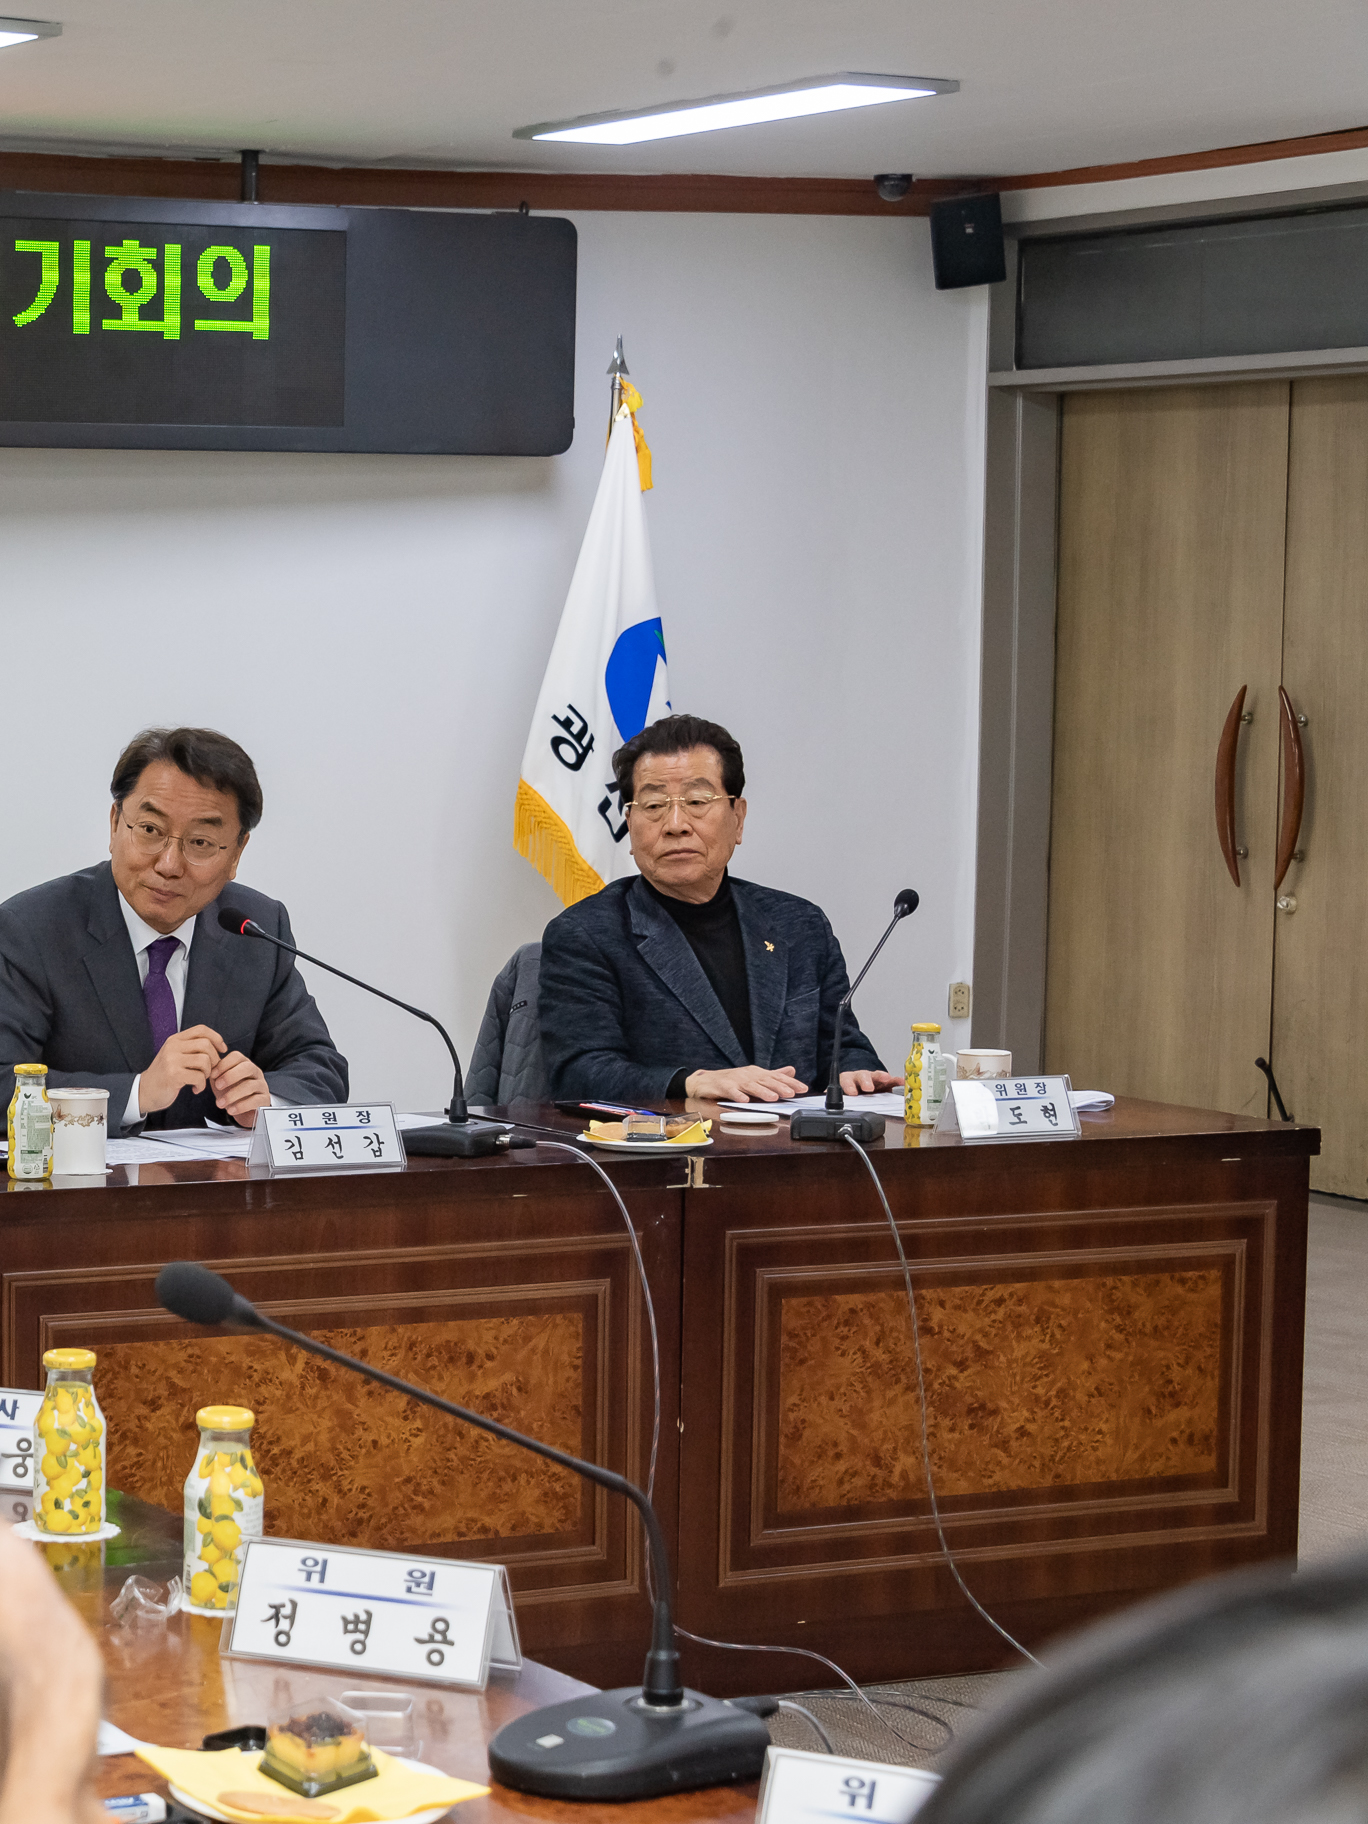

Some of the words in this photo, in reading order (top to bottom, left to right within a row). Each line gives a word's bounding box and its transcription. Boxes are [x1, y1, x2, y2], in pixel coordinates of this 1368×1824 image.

[984, 1082, 1047, 1097] 위원장
[1008, 1102, 1059, 1127] 도현
[839, 1776, 876, 1810] 위
